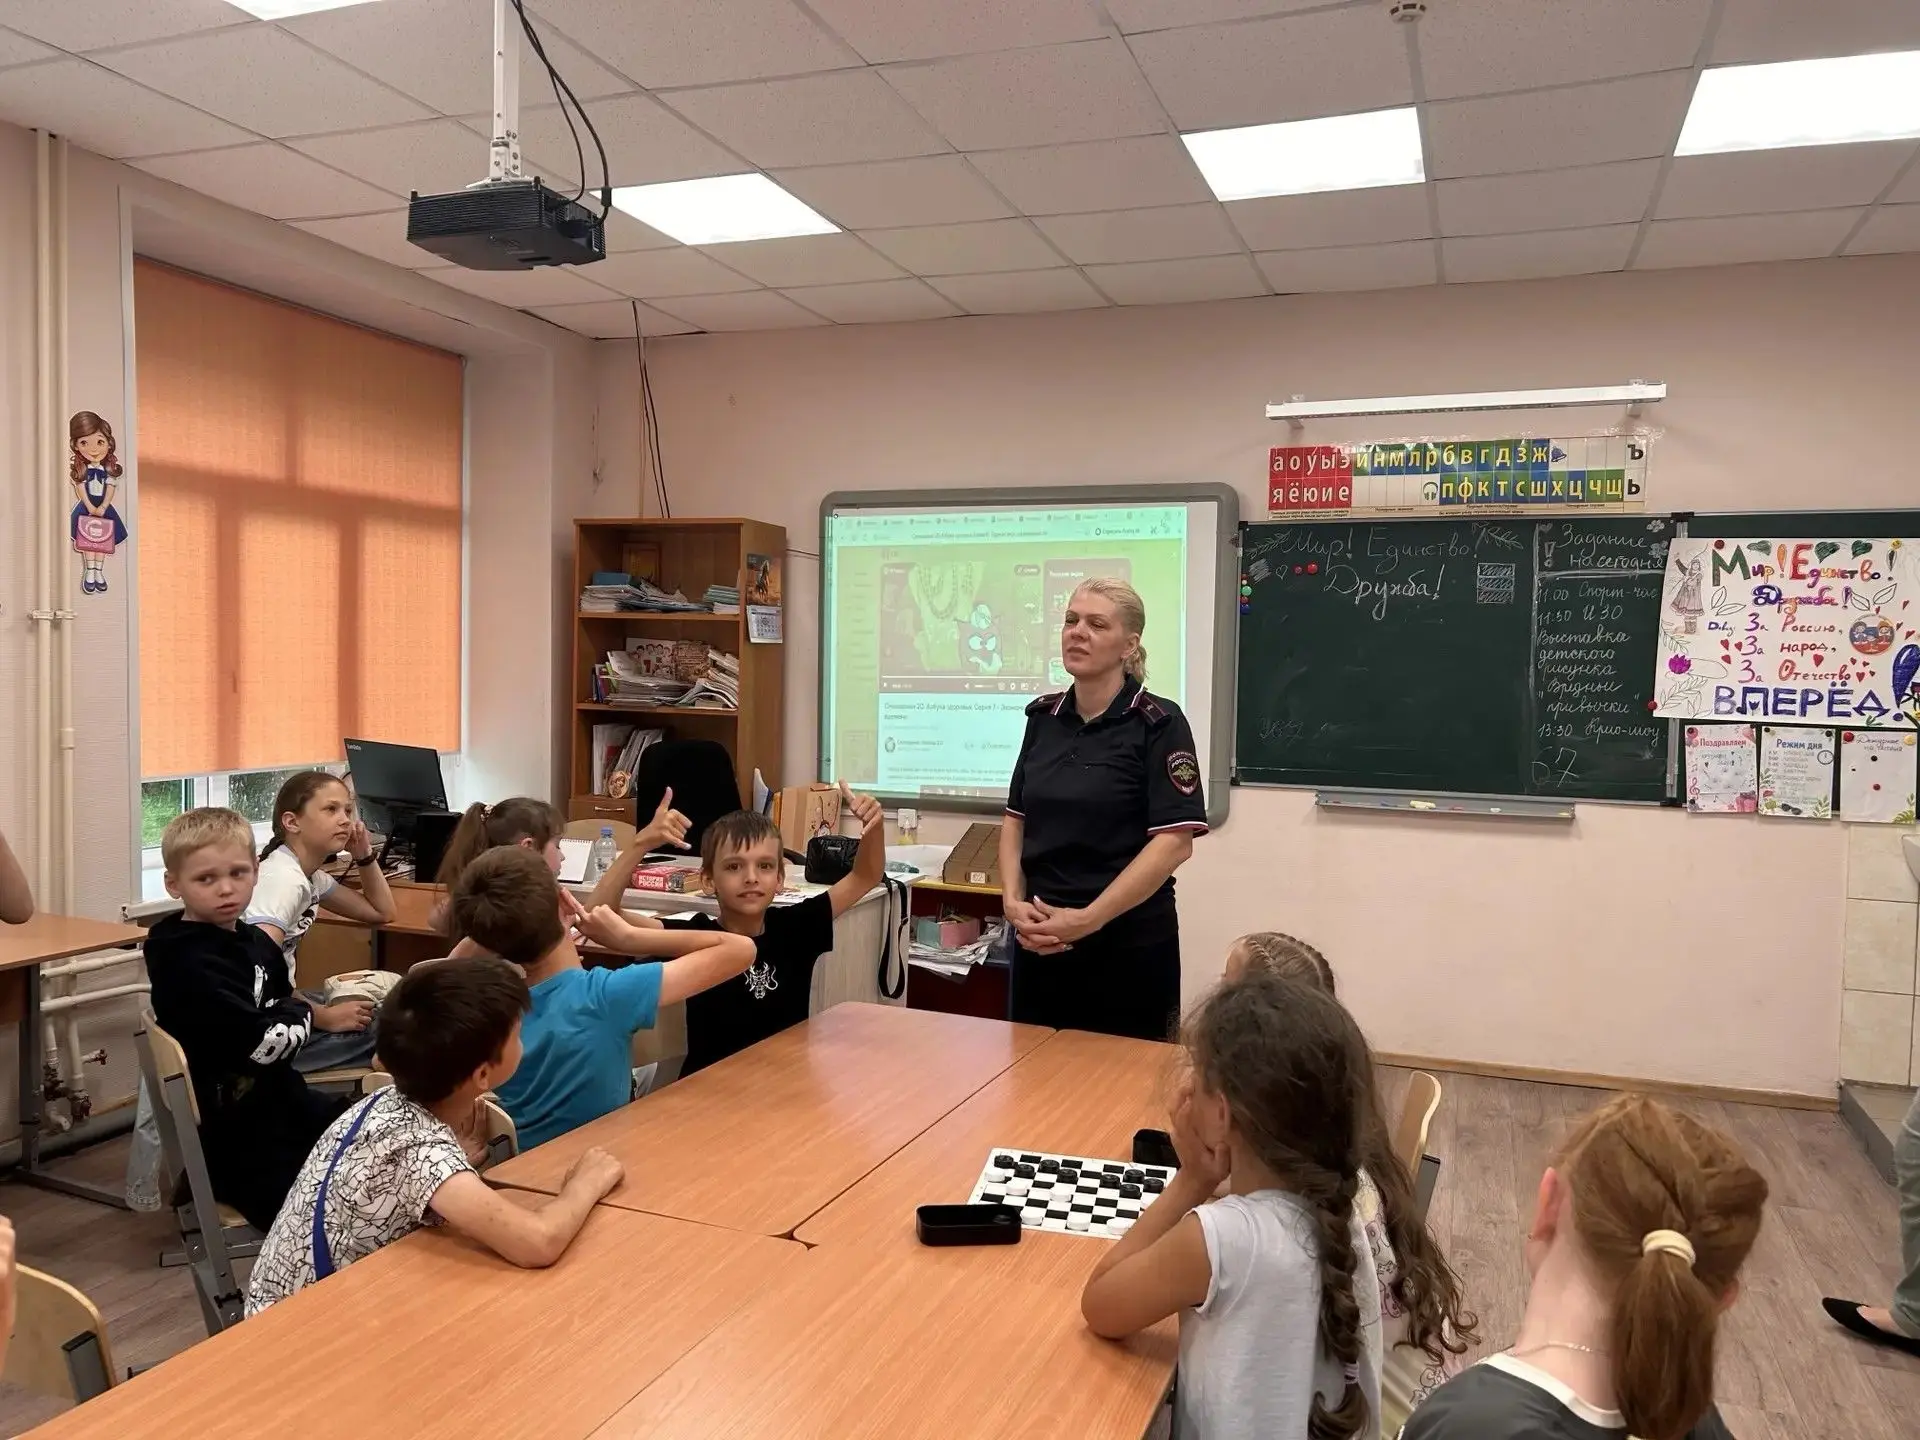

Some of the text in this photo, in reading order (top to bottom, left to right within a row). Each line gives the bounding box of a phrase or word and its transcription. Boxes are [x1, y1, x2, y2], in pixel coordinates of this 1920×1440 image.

[1273, 456, 1284, 471] а
[1289, 455, 1301, 470] о
[1321, 453, 1335, 470] ы
[1373, 452, 1385, 467] н
[1389, 451, 1404, 467] м
[1408, 451, 1420, 467] л
[1425, 450, 1437, 472] р
[1443, 444, 1455, 466] б
[1460, 449, 1473, 465] в
[1480, 448, 1489, 464] г
[1495, 447, 1511, 467] д
[1532, 447, 1548, 463] ж
[1272, 488, 1283, 504] я
[1288, 482, 1299, 503] ё
[1303, 487, 1318, 502] ю
[1321, 487, 1333, 502] и
[1338, 486, 1350, 501] е
[1442, 482, 1454, 498] п
[1458, 476, 1474, 503] ф
[1477, 481, 1489, 497] к
[1497, 481, 1508, 497] т
[1515, 481, 1525, 497] с
[1530, 480, 1547, 497] ш
[1551, 480, 1563, 496] х
[1569, 480, 1583, 500] ц
[1589, 479, 1601, 495] ч
[1606, 479, 1623, 498] щ
[1556, 523, 1648, 559] Задание
[1324, 564, 1445, 621] Дружба!
[1744, 612, 1769, 632] За
[1537, 624, 1631, 646] Выставка
[1741, 635, 1765, 656] За
[1537, 648, 1616, 669] детского
[1738, 659, 1852, 684] За Отечество
[1700, 738, 1747, 748] Поздравляем
[1776, 738, 1823, 750] Режим дня
